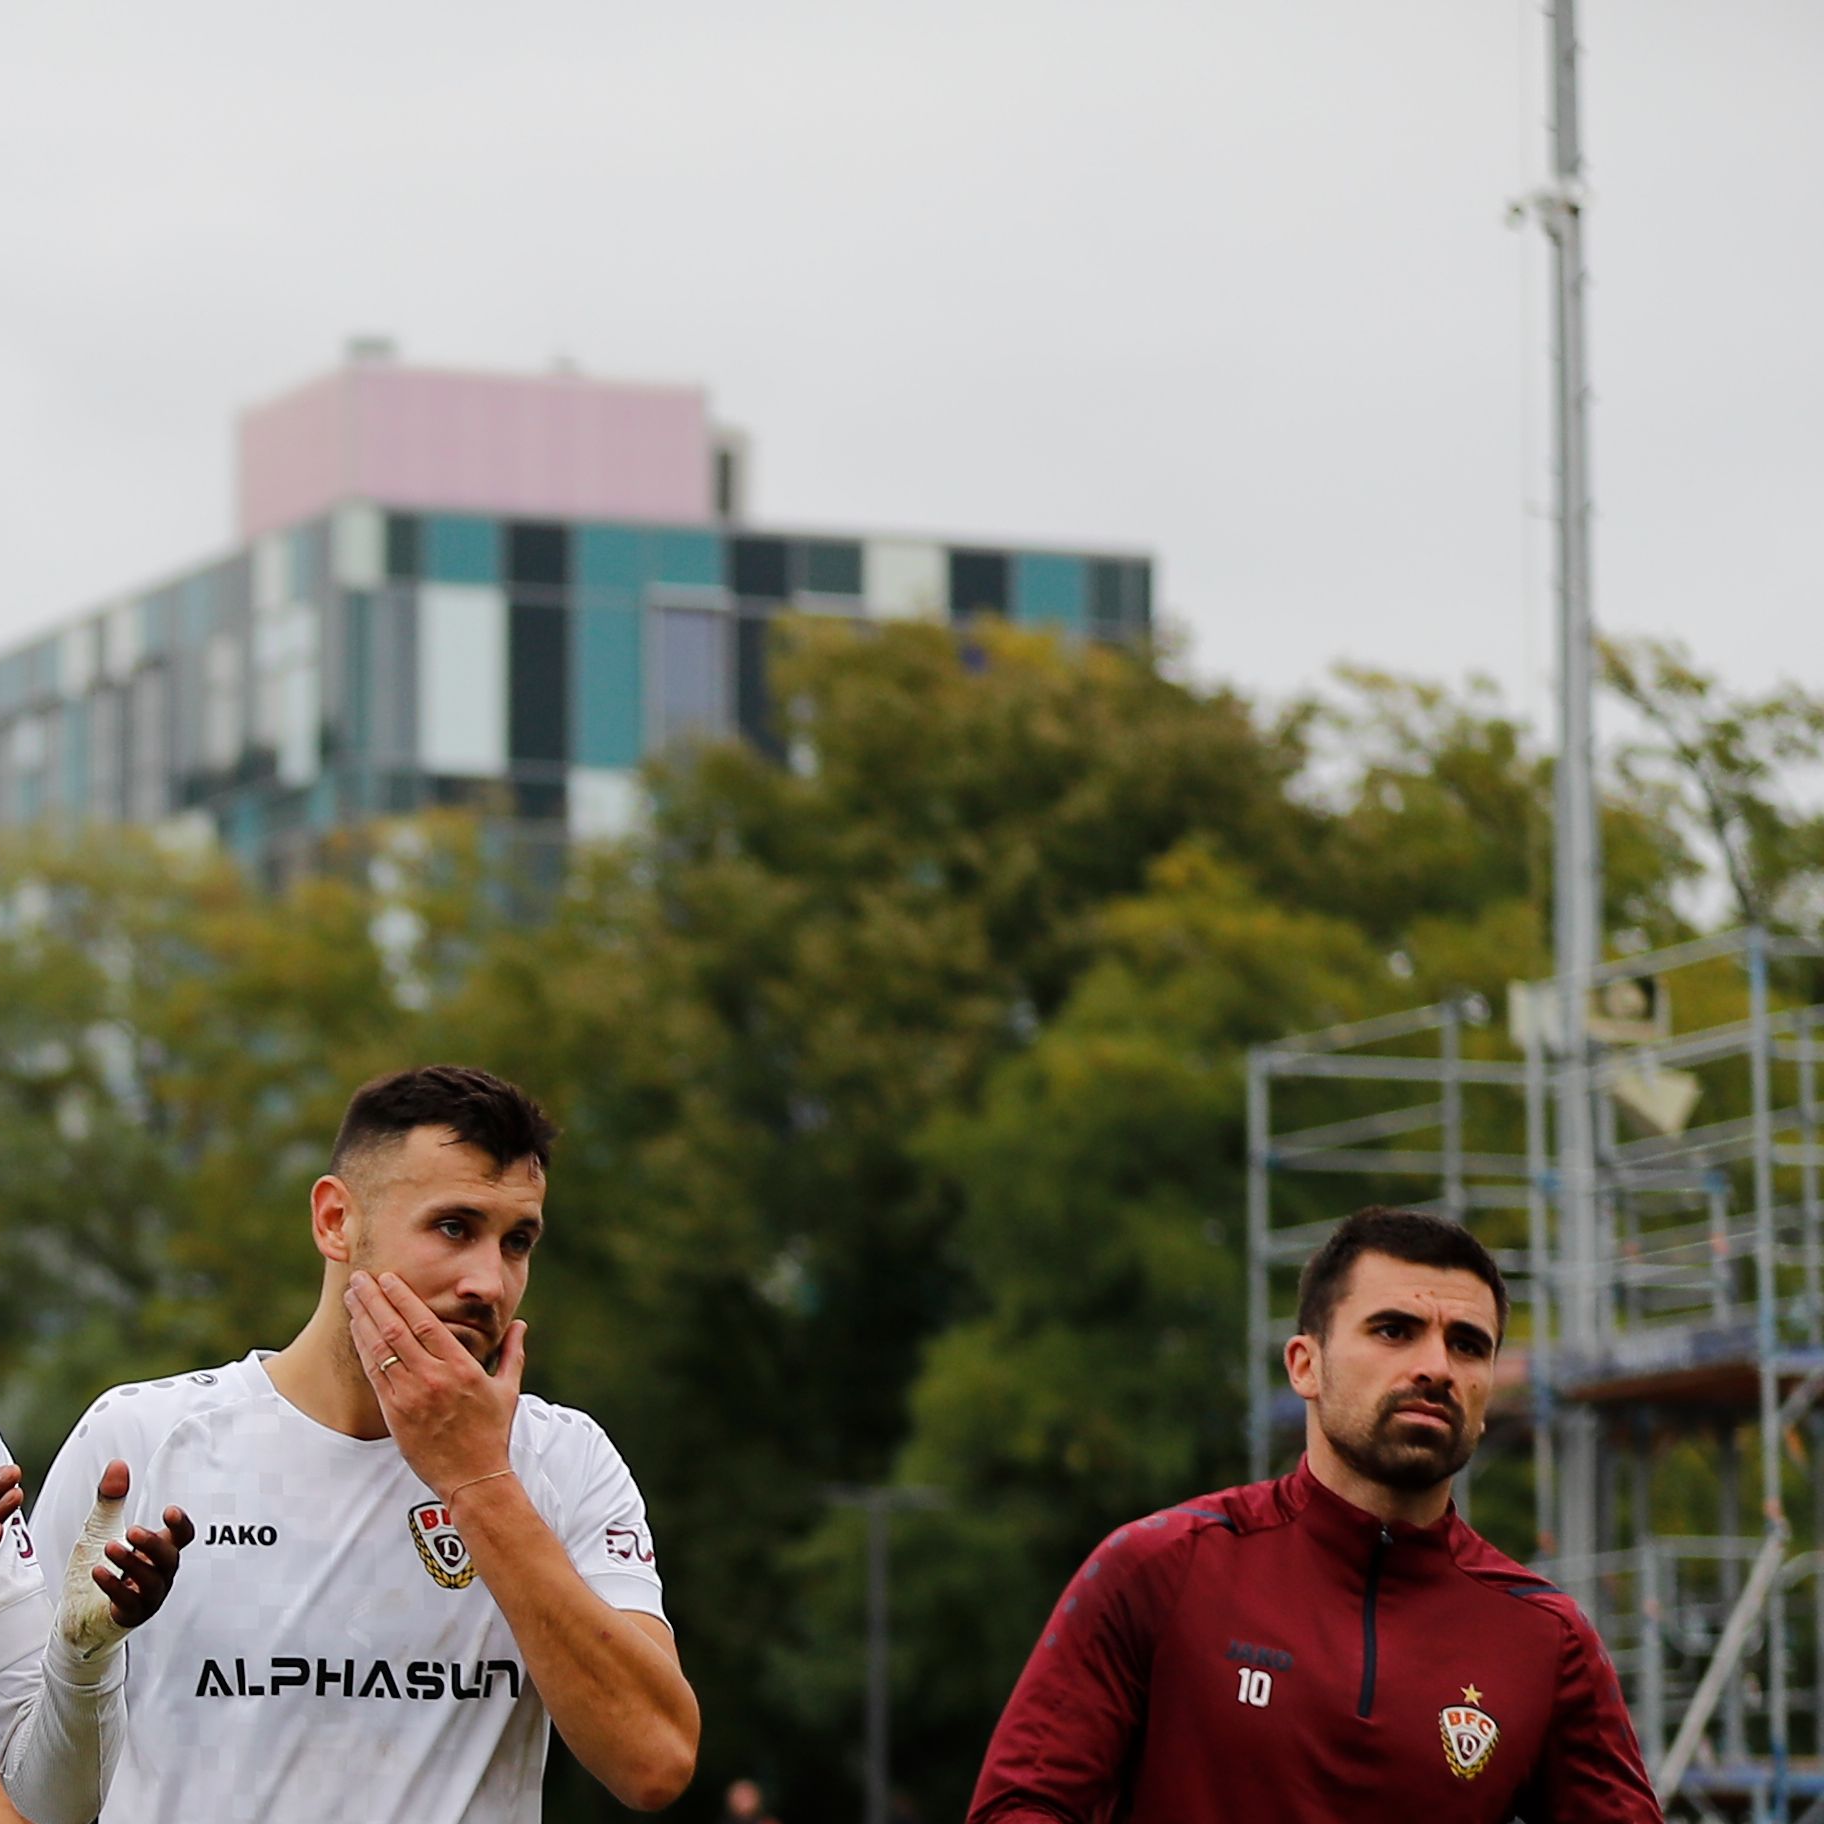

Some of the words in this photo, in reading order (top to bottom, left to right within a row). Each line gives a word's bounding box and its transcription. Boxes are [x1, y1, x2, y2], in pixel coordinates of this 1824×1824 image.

[205, 1524, 278, 1546] JAKO
[196, 1657, 519, 1701] ALPHASUN
[1238, 1667, 1272, 1708] 10
[1447, 1710, 1494, 1738] BFC
